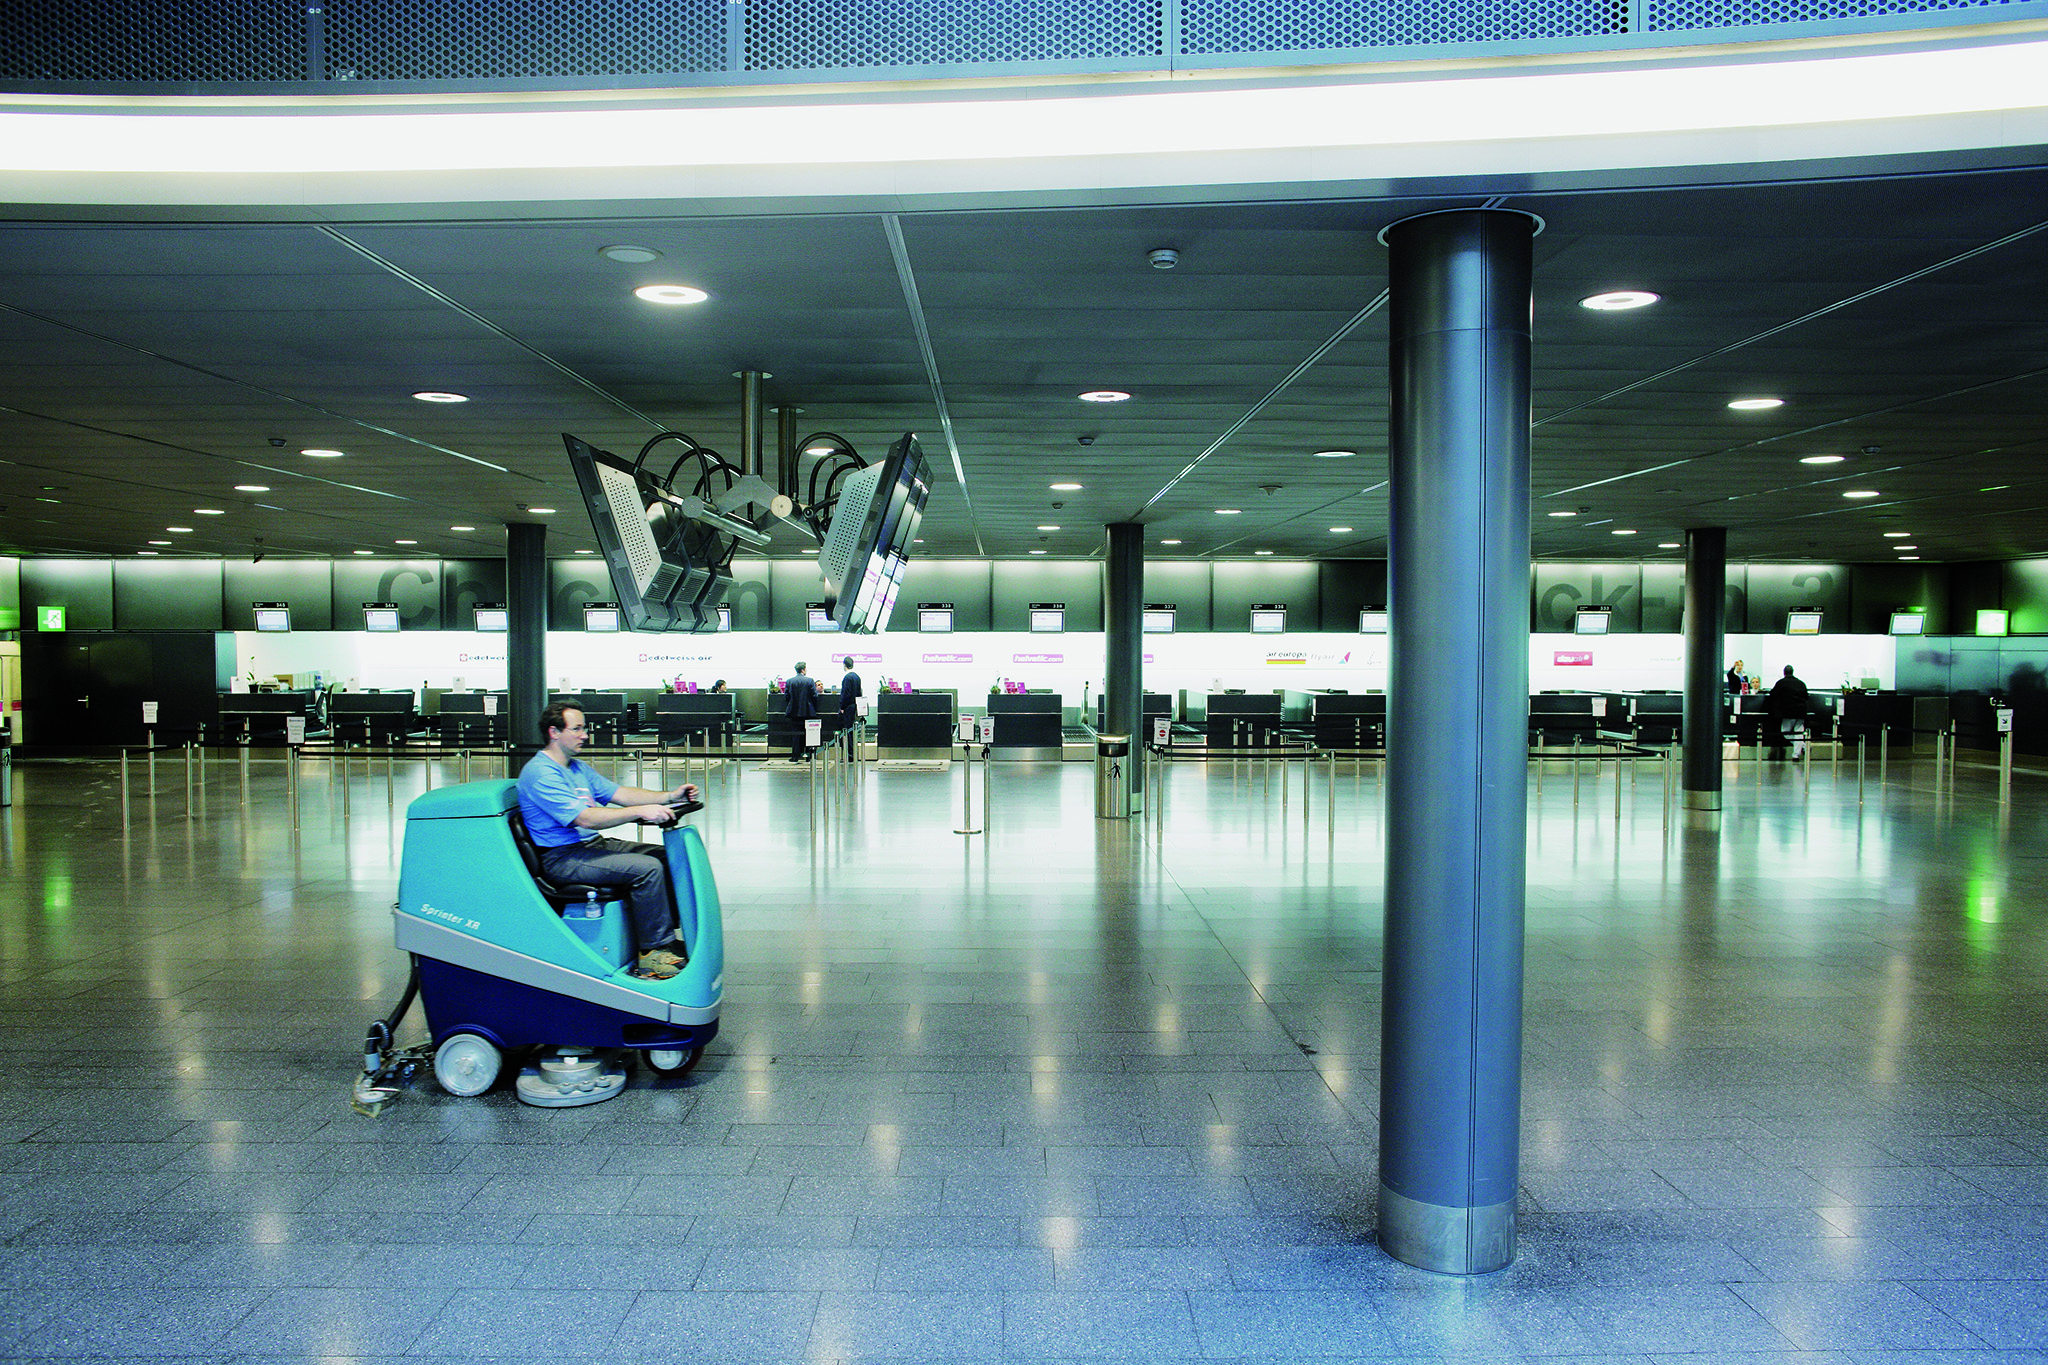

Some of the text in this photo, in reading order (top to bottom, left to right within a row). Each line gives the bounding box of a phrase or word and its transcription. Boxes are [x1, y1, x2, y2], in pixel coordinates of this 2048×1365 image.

[924, 654, 972, 662] helvetic.com
[1014, 654, 1062, 662] helvetic.com
[1278, 651, 1307, 659] europa
[421, 903, 464, 924] Sprinter
